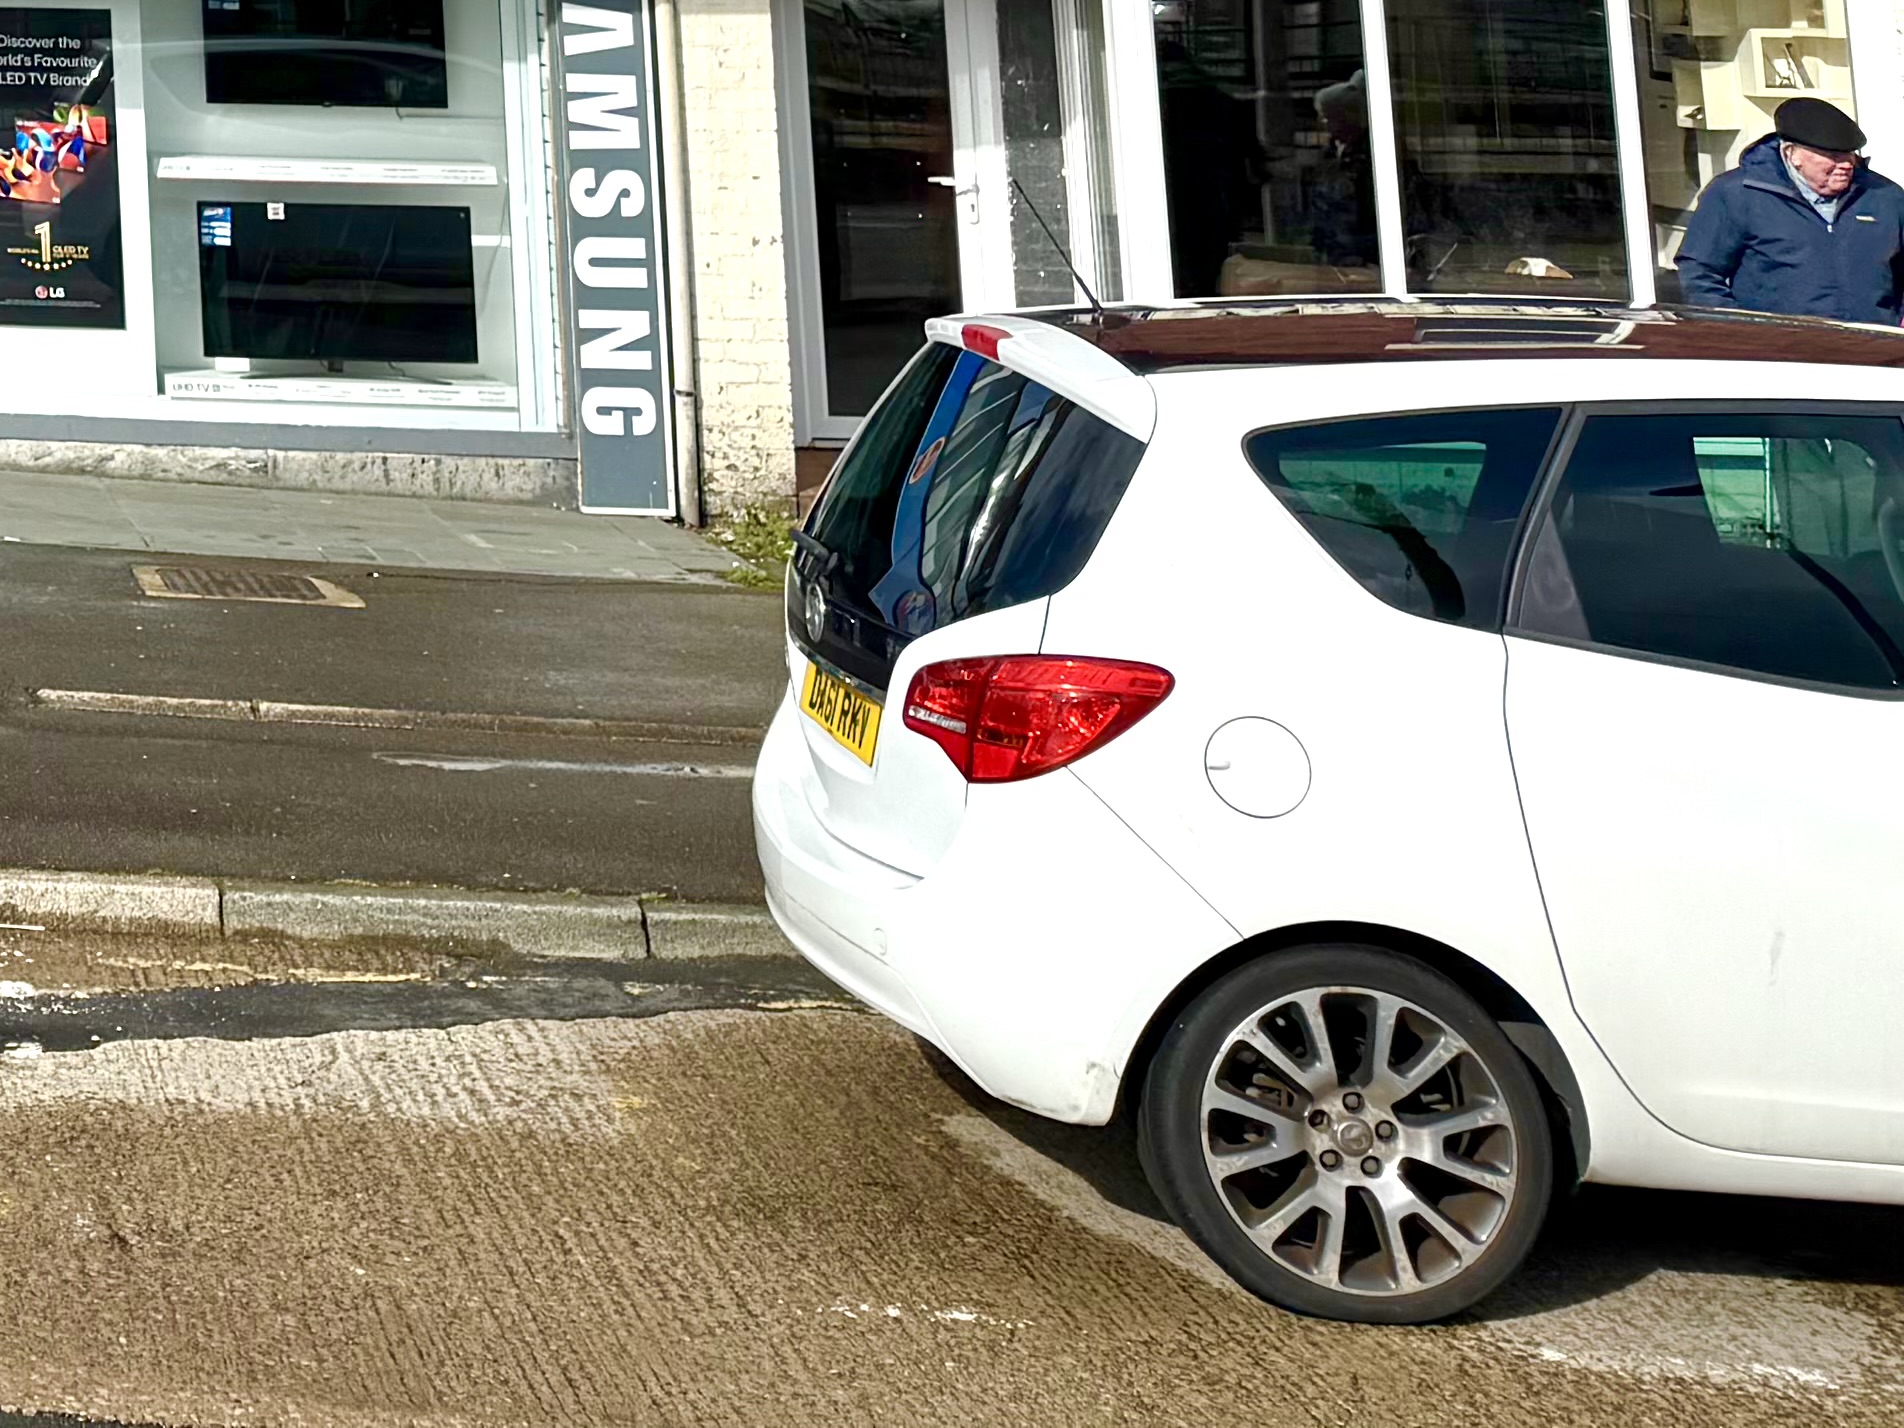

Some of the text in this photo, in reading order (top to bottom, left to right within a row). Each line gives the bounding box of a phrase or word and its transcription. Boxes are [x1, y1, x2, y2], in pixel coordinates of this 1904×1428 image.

[58, 36, 81, 49] the
[34, 54, 98, 68] Favourite
[29, 72, 47, 85] TV
[50, 72, 91, 87] Brand
[49, 287, 65, 298] LG
